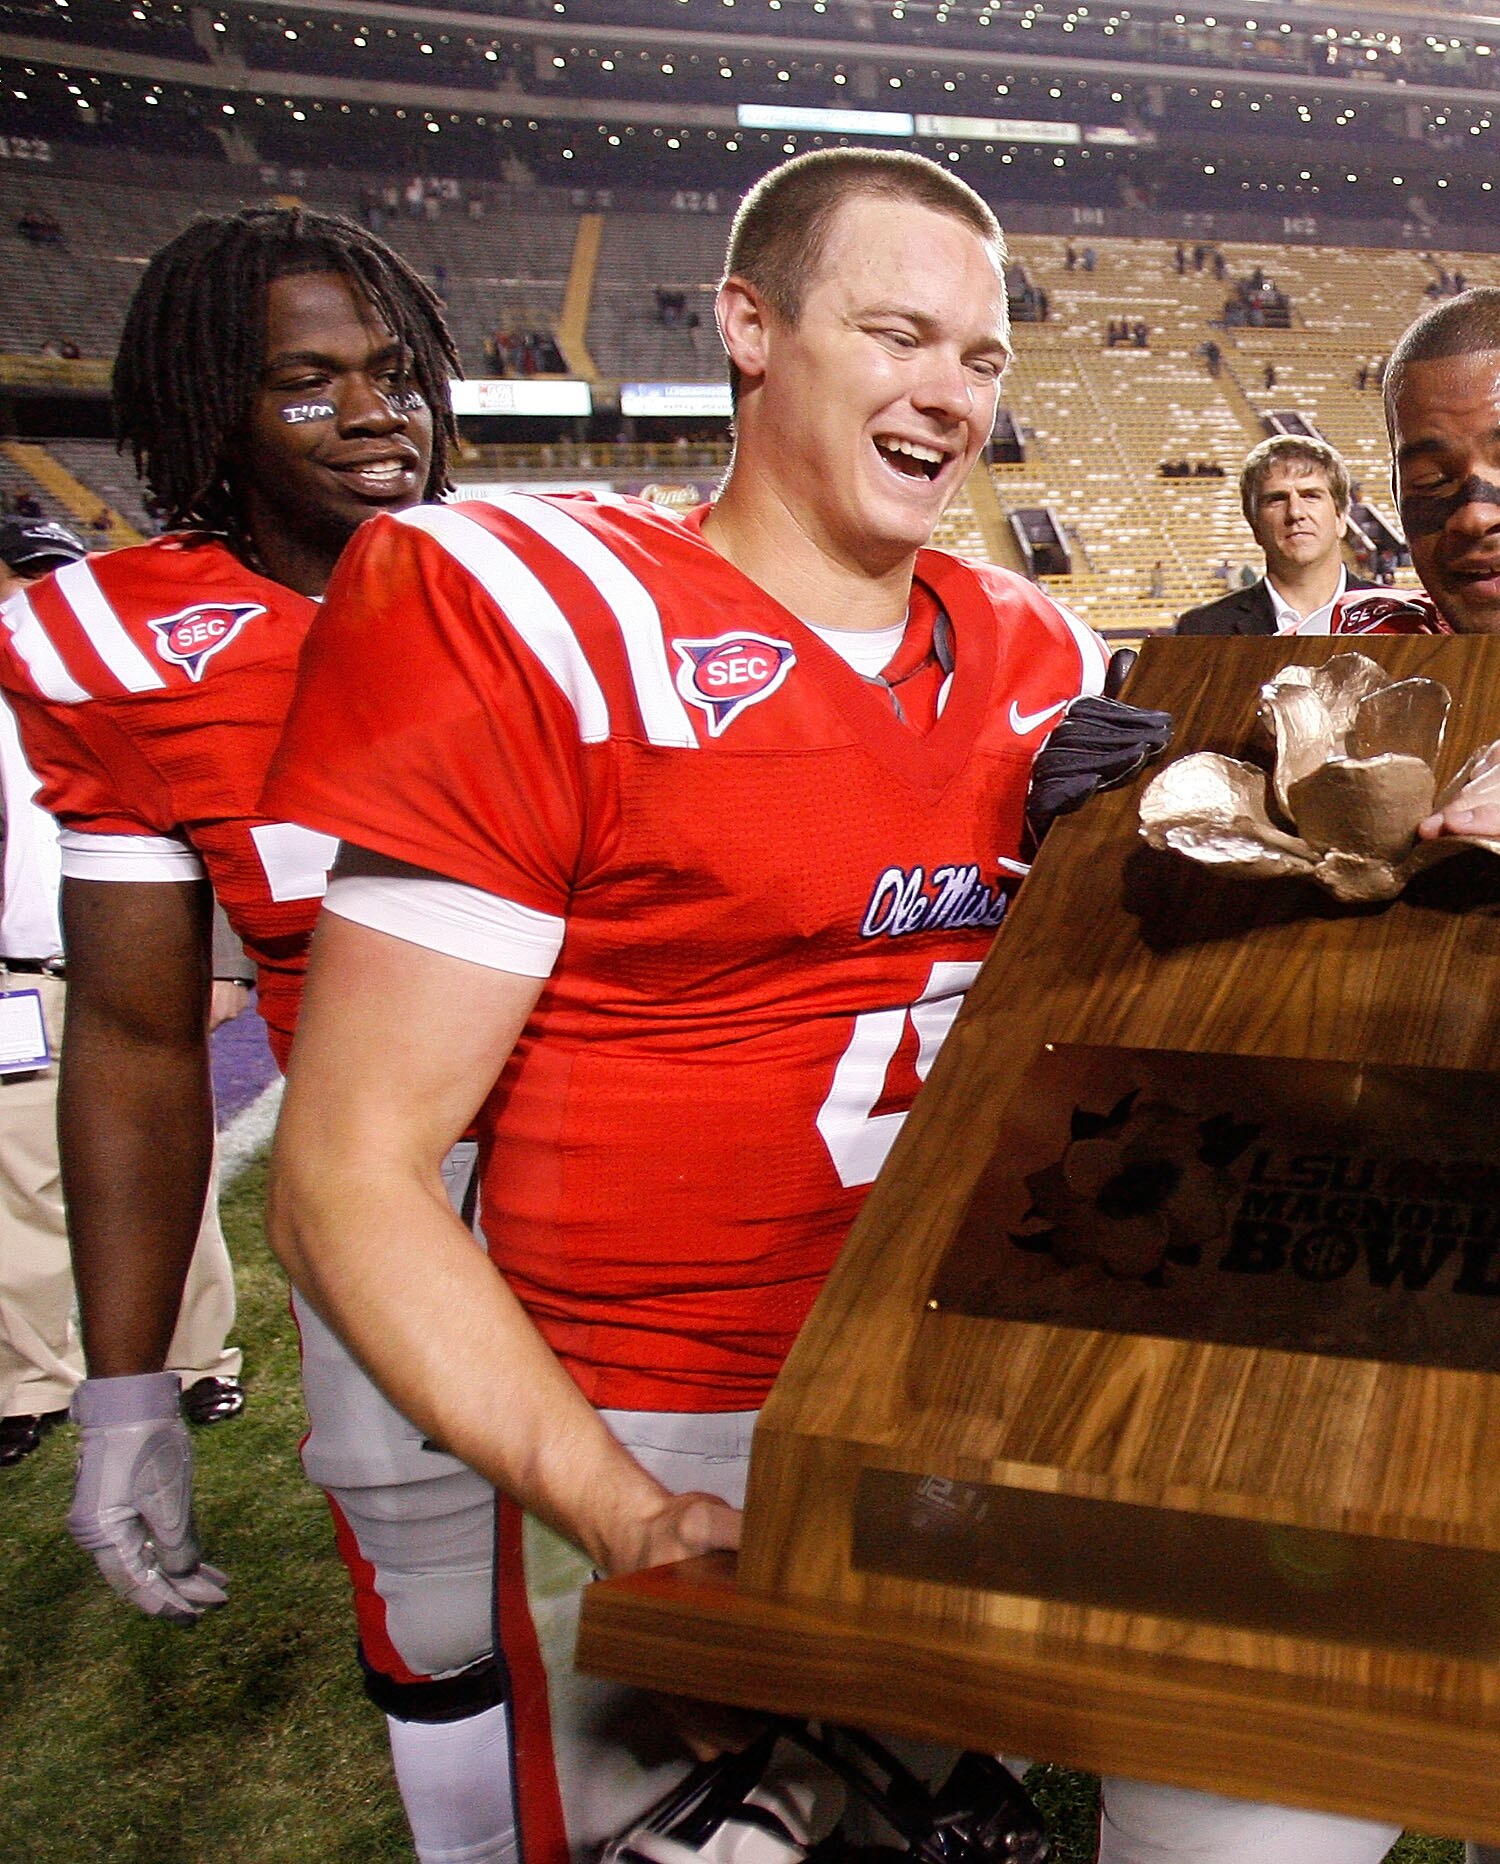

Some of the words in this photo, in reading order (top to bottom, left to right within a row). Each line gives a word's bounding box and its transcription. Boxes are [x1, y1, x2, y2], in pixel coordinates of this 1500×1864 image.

[1347, 604, 1389, 627] SEC
[176, 618, 226, 647] SEC
[706, 656, 769, 687] SEC
[861, 865, 930, 938] Ole
[1248, 1150, 1376, 1192] LSU
